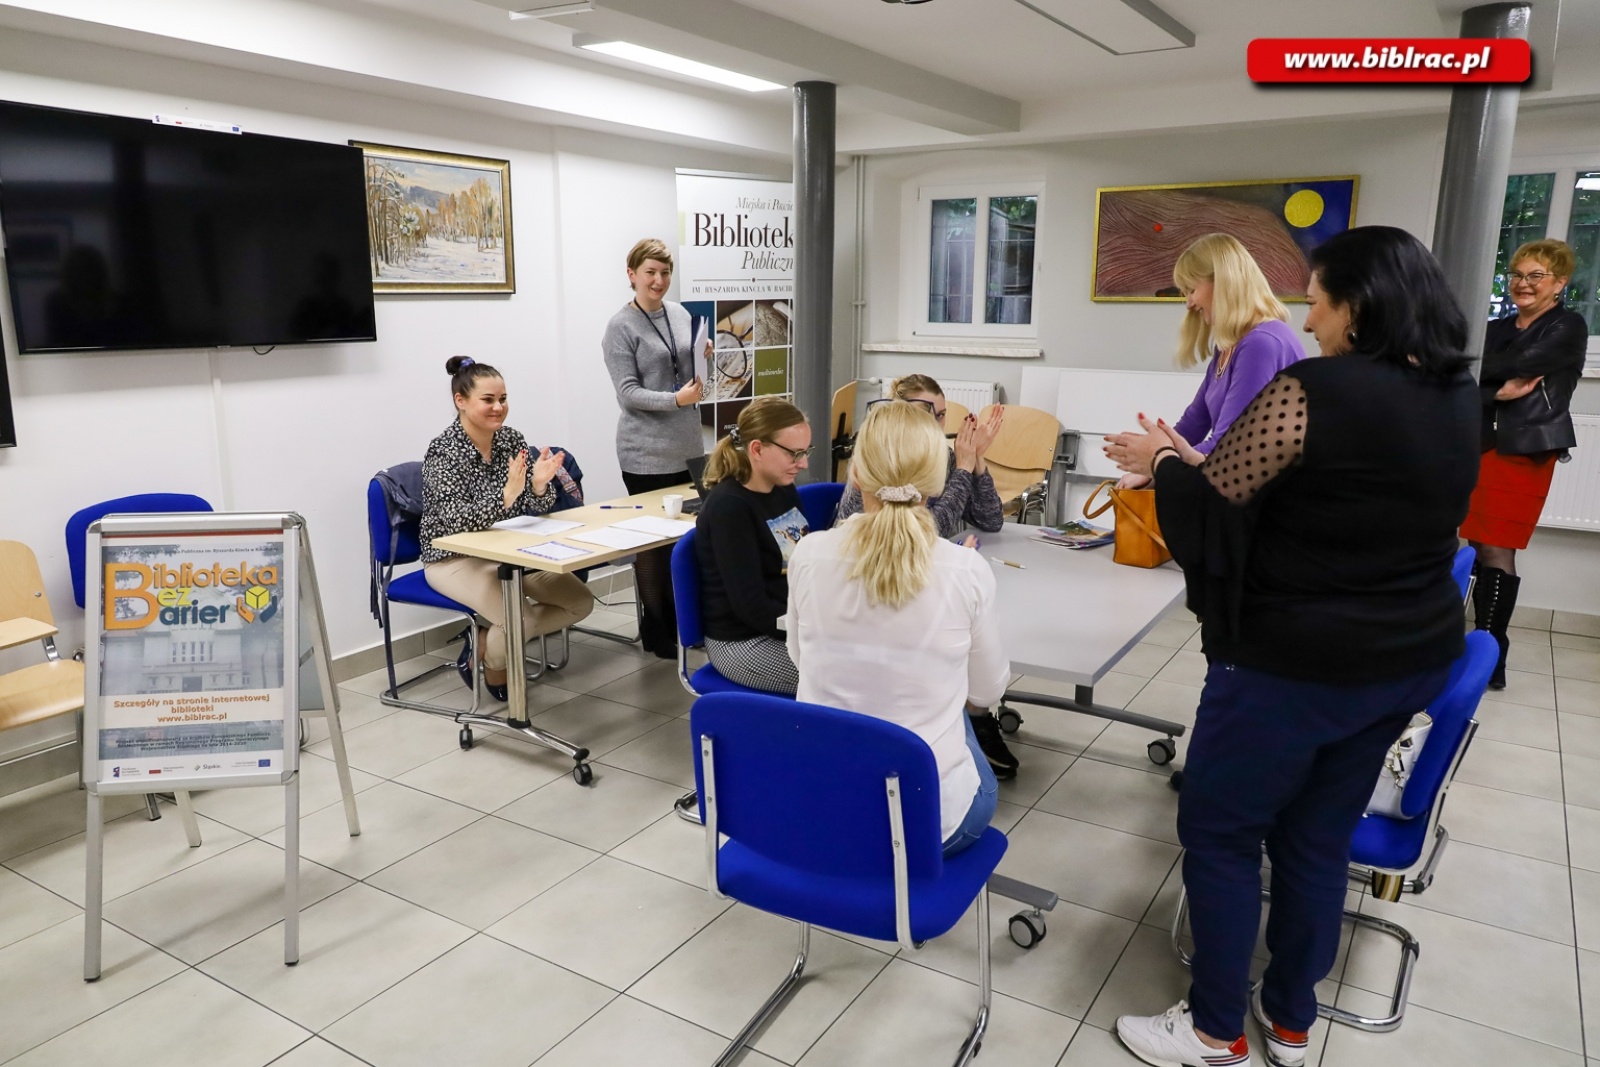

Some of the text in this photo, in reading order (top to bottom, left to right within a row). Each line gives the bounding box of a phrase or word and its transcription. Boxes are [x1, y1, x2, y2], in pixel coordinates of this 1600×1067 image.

[735, 197, 766, 212] Miejska
[693, 213, 793, 248] Bibliotek
[741, 250, 793, 272] Publiczn
[704, 285, 740, 294] RYSZARDA
[741, 285, 766, 293] KINCLA
[114, 699, 160, 708] Szczegóły
[176, 697, 209, 705] stronie
[211, 694, 270, 703] internetowej
[171, 705, 214, 713] biblioteki
[157, 712, 227, 722] www.biblrac.pl
